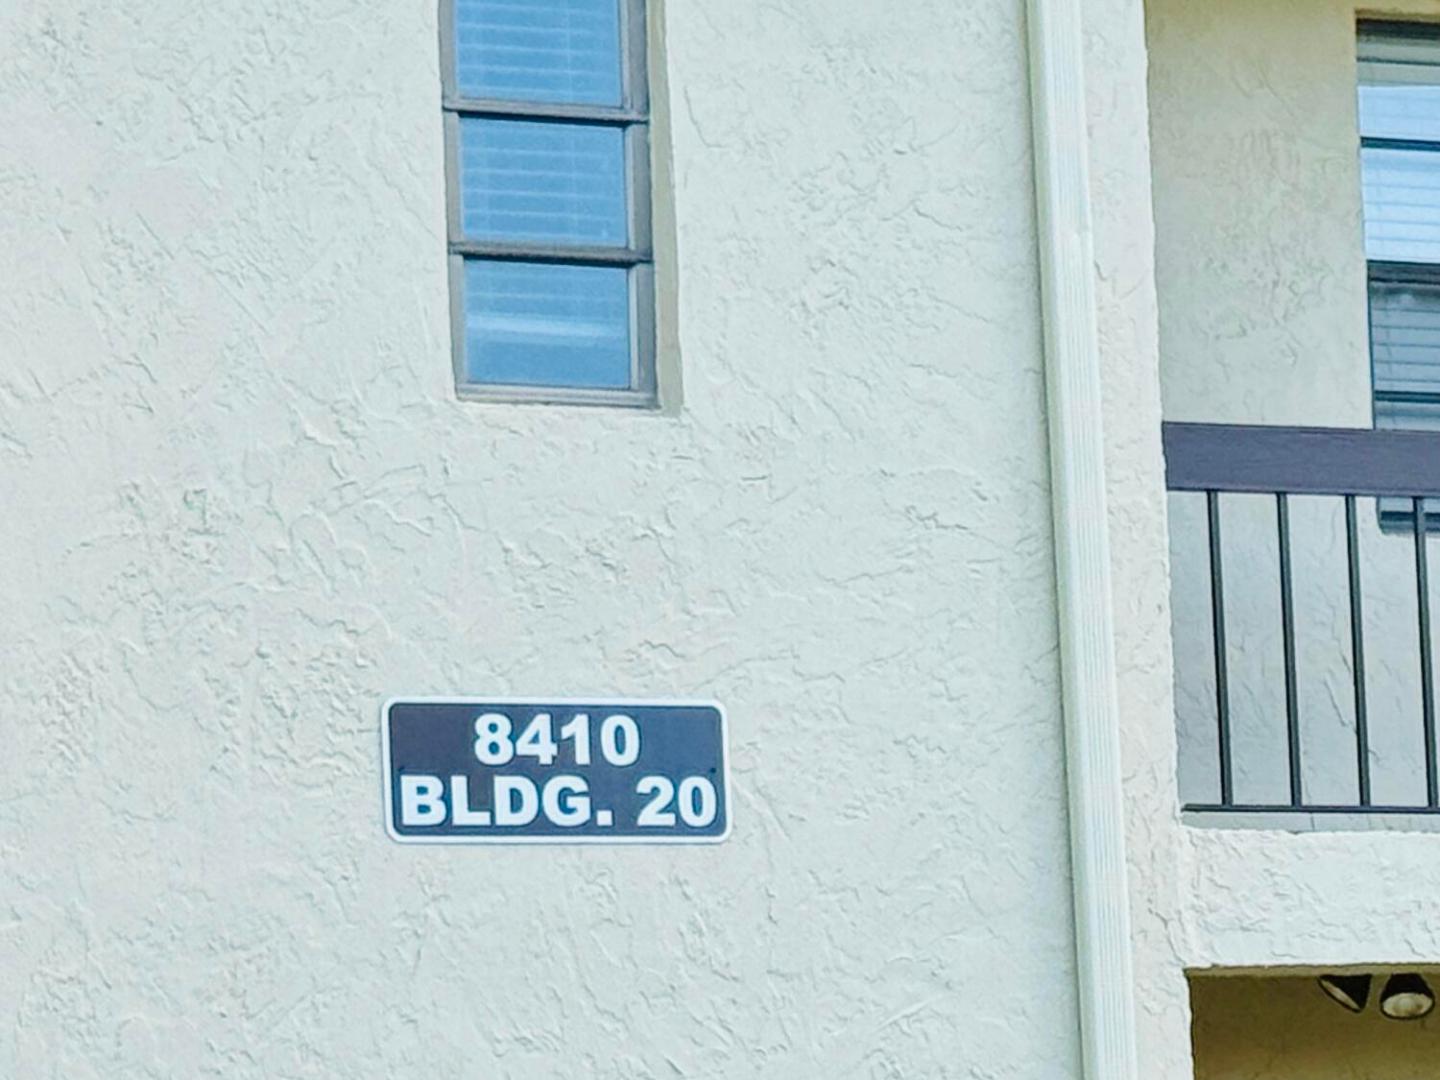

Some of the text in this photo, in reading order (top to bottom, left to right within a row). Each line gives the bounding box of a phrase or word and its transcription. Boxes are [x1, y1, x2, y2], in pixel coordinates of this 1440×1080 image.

[474, 713, 640, 766] 8410
[400, 774, 717, 828] BLDG. 20
